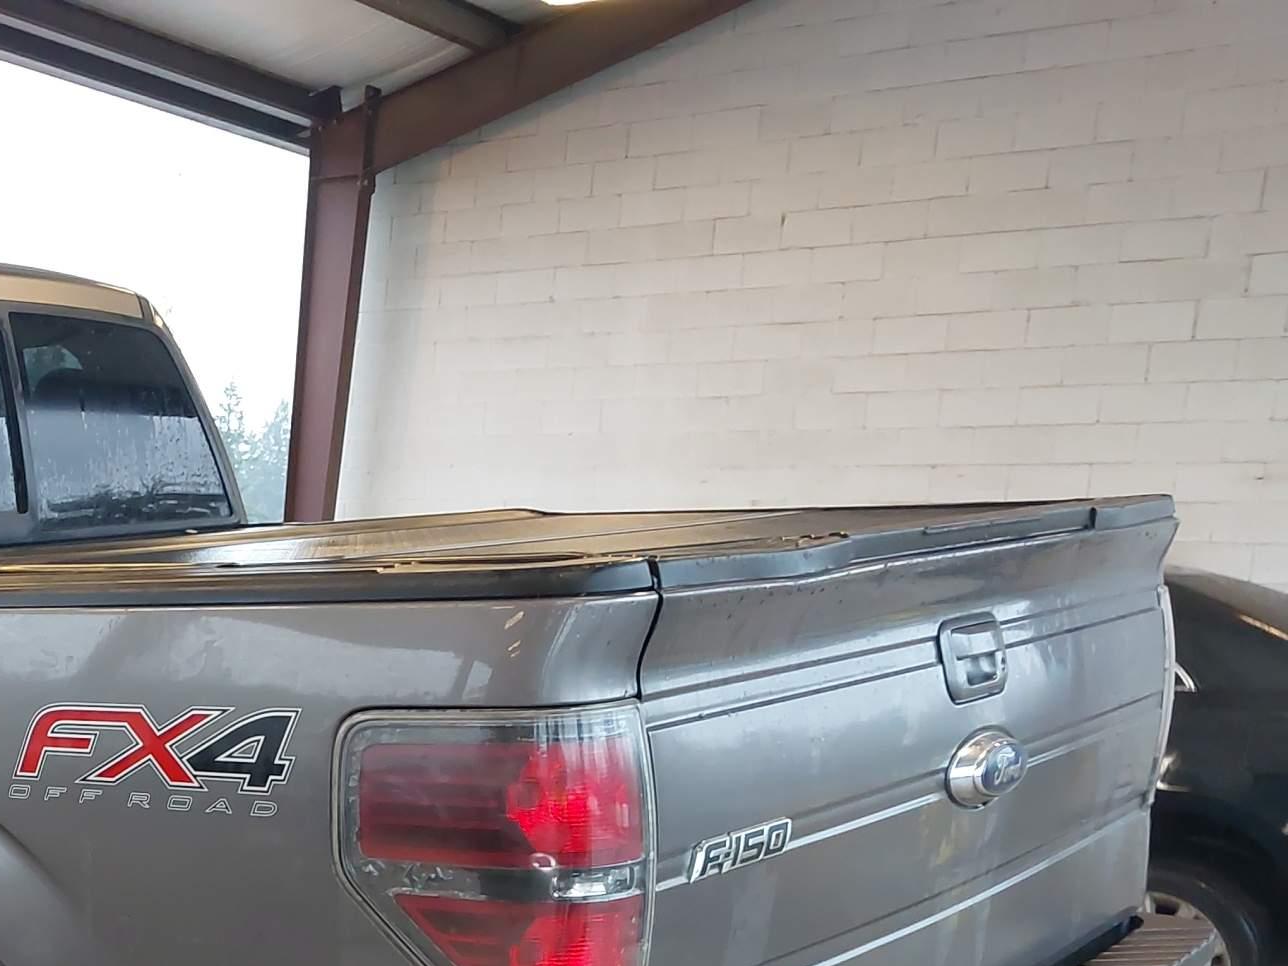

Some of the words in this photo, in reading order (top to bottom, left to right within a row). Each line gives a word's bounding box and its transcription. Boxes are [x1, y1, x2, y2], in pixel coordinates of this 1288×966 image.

[13, 702, 302, 795] FX4
[8, 784, 103, 804] OFF
[128, 792, 278, 817] ROAD
[688, 817, 792, 884] F-150
